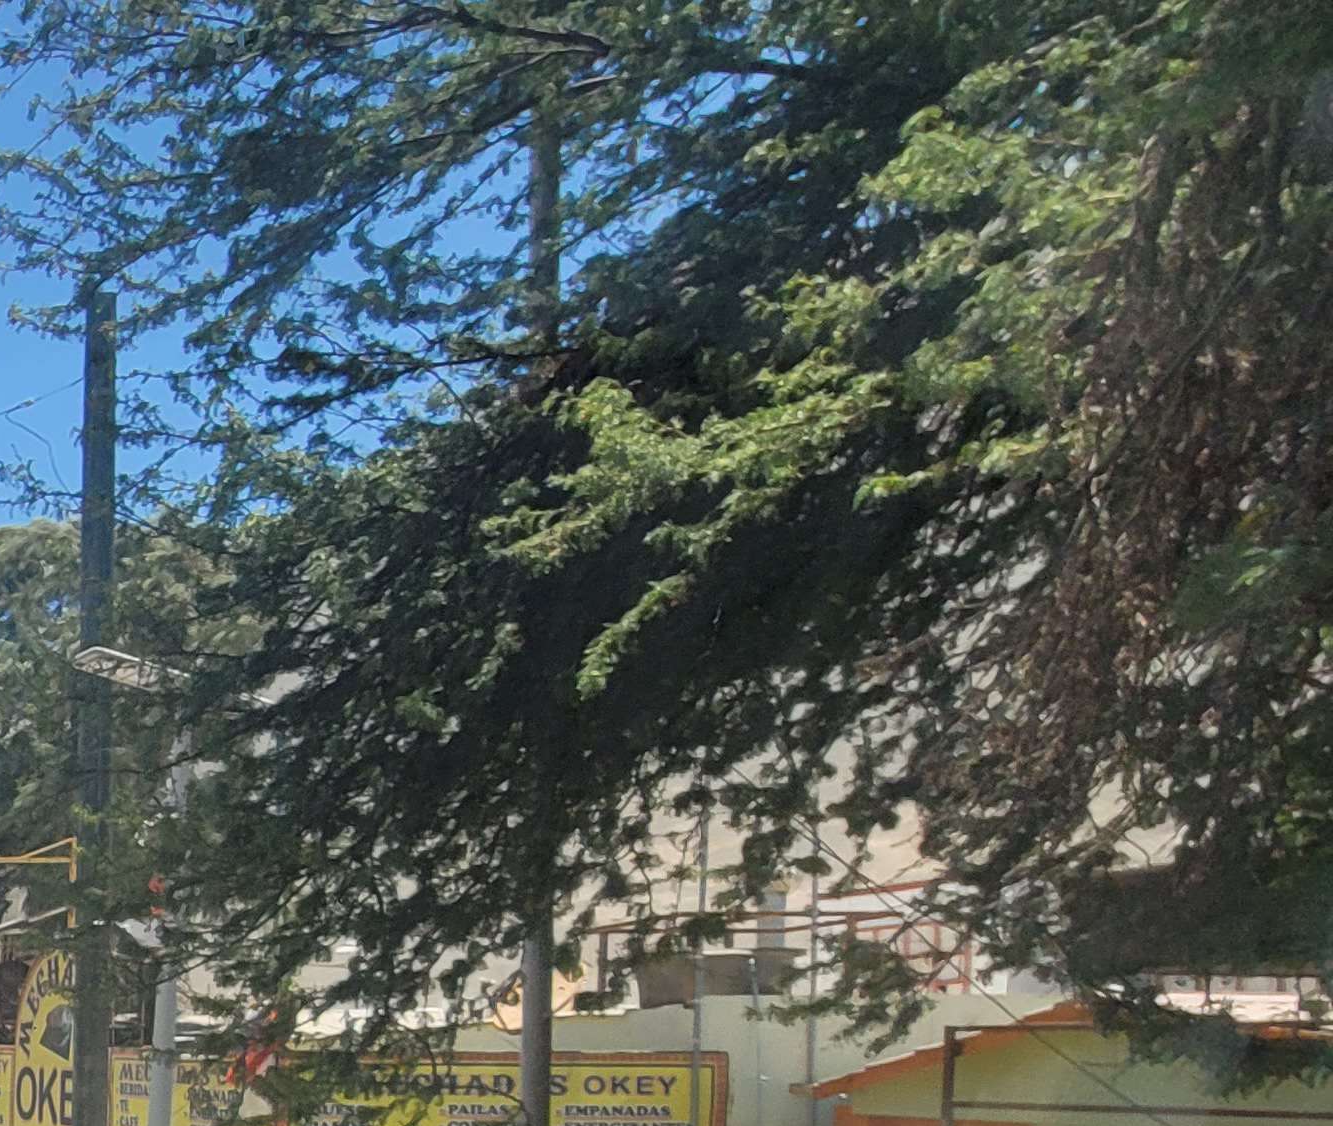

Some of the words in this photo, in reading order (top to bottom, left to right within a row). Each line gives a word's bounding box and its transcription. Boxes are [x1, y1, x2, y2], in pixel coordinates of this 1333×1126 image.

[120, 1083, 149, 1097] BEBIDA
[584, 1075, 678, 1095] OKEY
[16, 1066, 74, 1126] OKE
[564, 1105, 671, 1116] EMPANADAS
